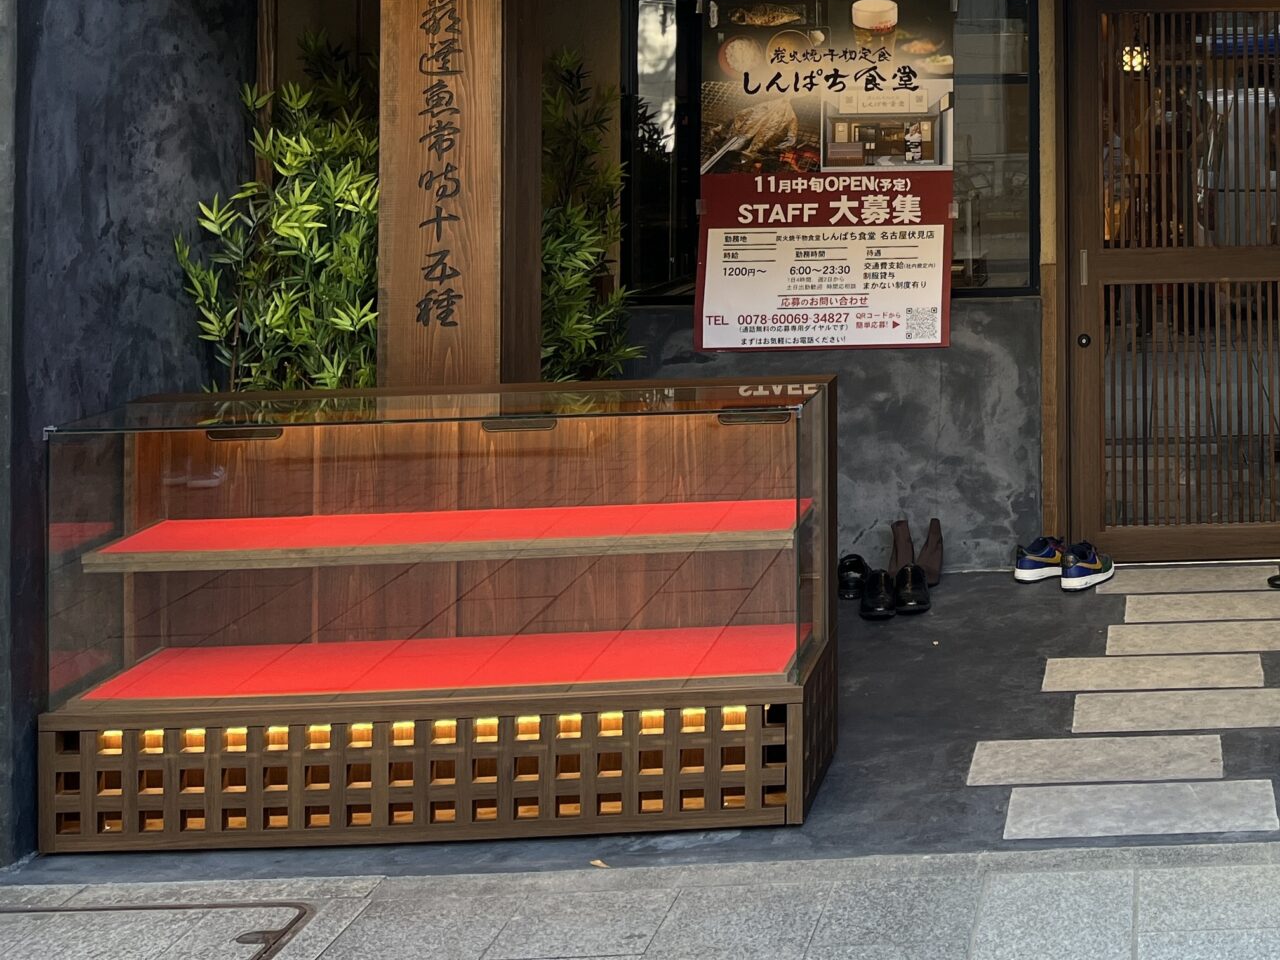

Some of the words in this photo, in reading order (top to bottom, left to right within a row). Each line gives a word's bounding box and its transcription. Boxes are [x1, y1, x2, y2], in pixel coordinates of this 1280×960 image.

[770, 46, 893, 65] 炭火焼干物定食
[743, 65, 920, 94] しんぱち食堂
[754, 175, 911, 194] 11月中旬OPEN(予定)
[738, 203, 818, 224] STAFF
[828, 194, 922, 225] 大募集
[724, 235, 748, 243] 勤務地
[880, 230, 935, 240] 名古屋伏見店
[723, 251, 739, 259] 時給
[795, 250, 826, 258] 勤務時間
[866, 249, 881, 257] 待遇
[781, 296, 869, 307] 応募のお問い合わせ
[705, 315, 729, 326] TEL
[737, 312, 850, 326] 0078-60069-34827
